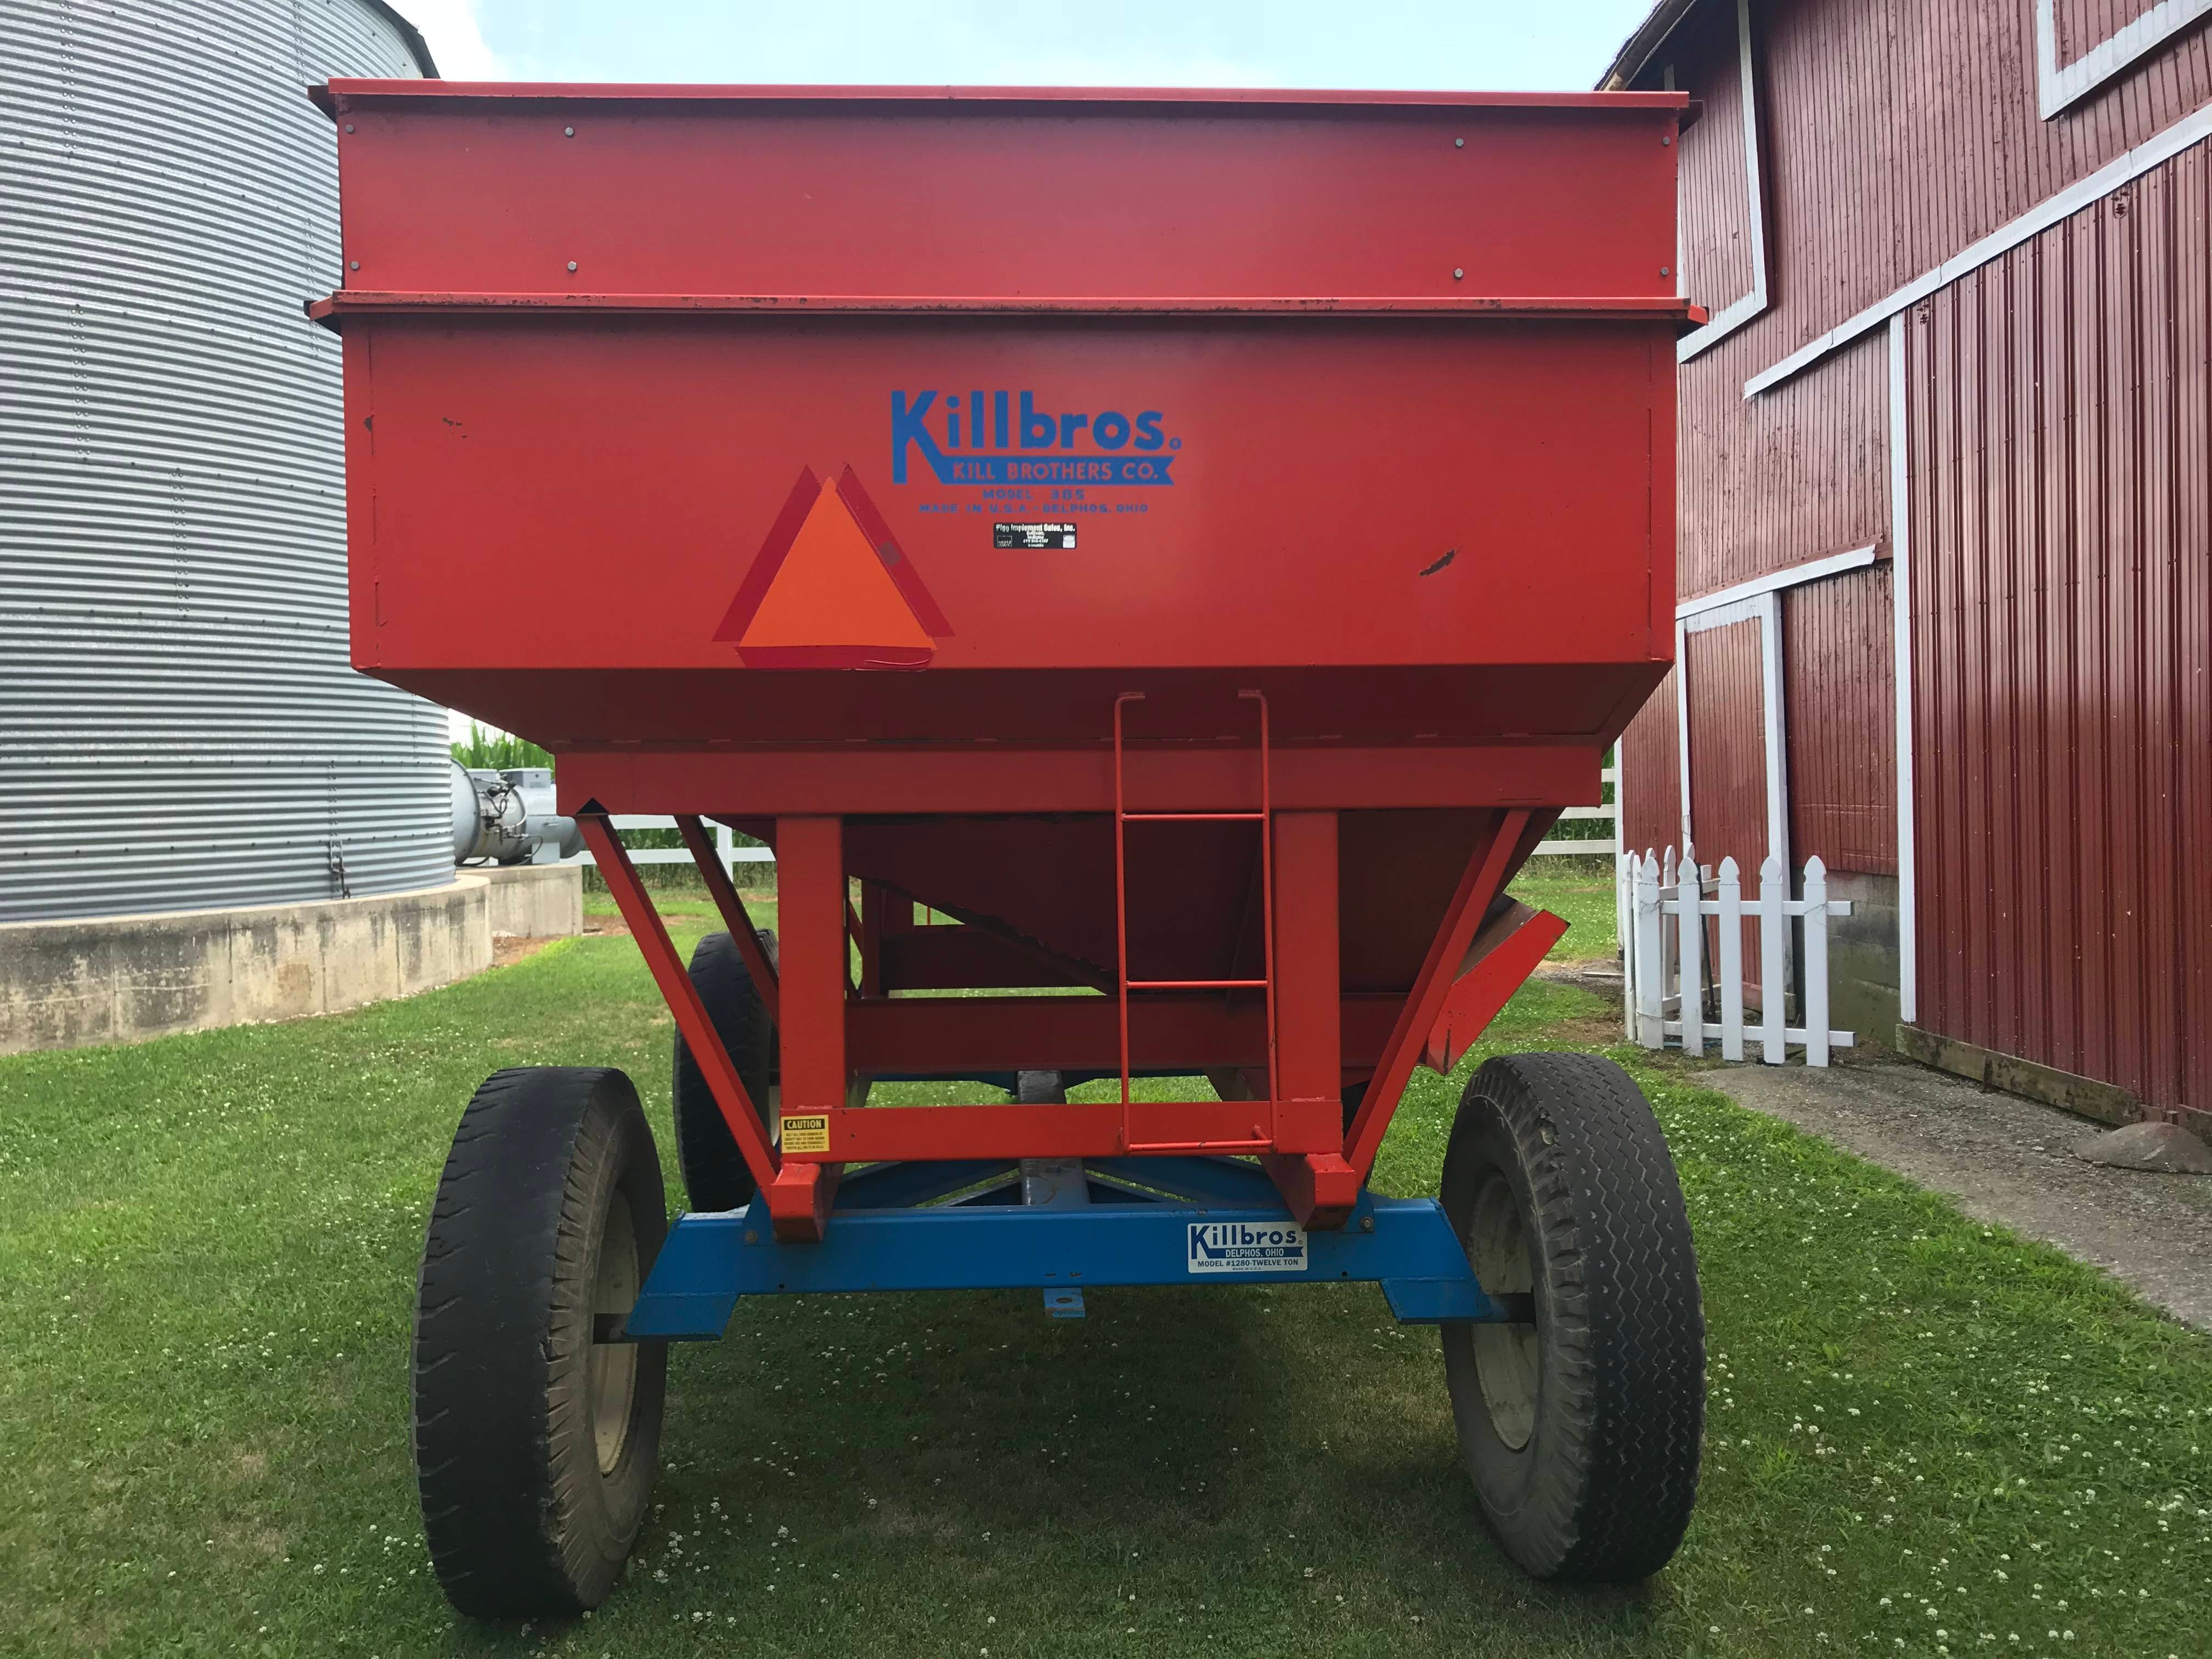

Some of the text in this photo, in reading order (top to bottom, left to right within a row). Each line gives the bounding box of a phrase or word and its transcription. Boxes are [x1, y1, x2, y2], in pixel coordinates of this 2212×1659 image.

[891, 390, 1165, 484] Killbros
[953, 462, 1159, 479] KILL BROTHERS CO.
[982, 489, 1033, 500] MODEL
[919, 503, 958, 514] MADE
[966, 503, 982, 514] IN
[1116, 503, 1148, 514] OHIO
[1011, 524, 1042, 532] Implement
[1043, 523, 1063, 532] Sales,
[787, 1120, 822, 1129] CAUTION
[1191, 1224, 1297, 1260] Killbros
[1265, 1248, 1284, 1257] OHIO
